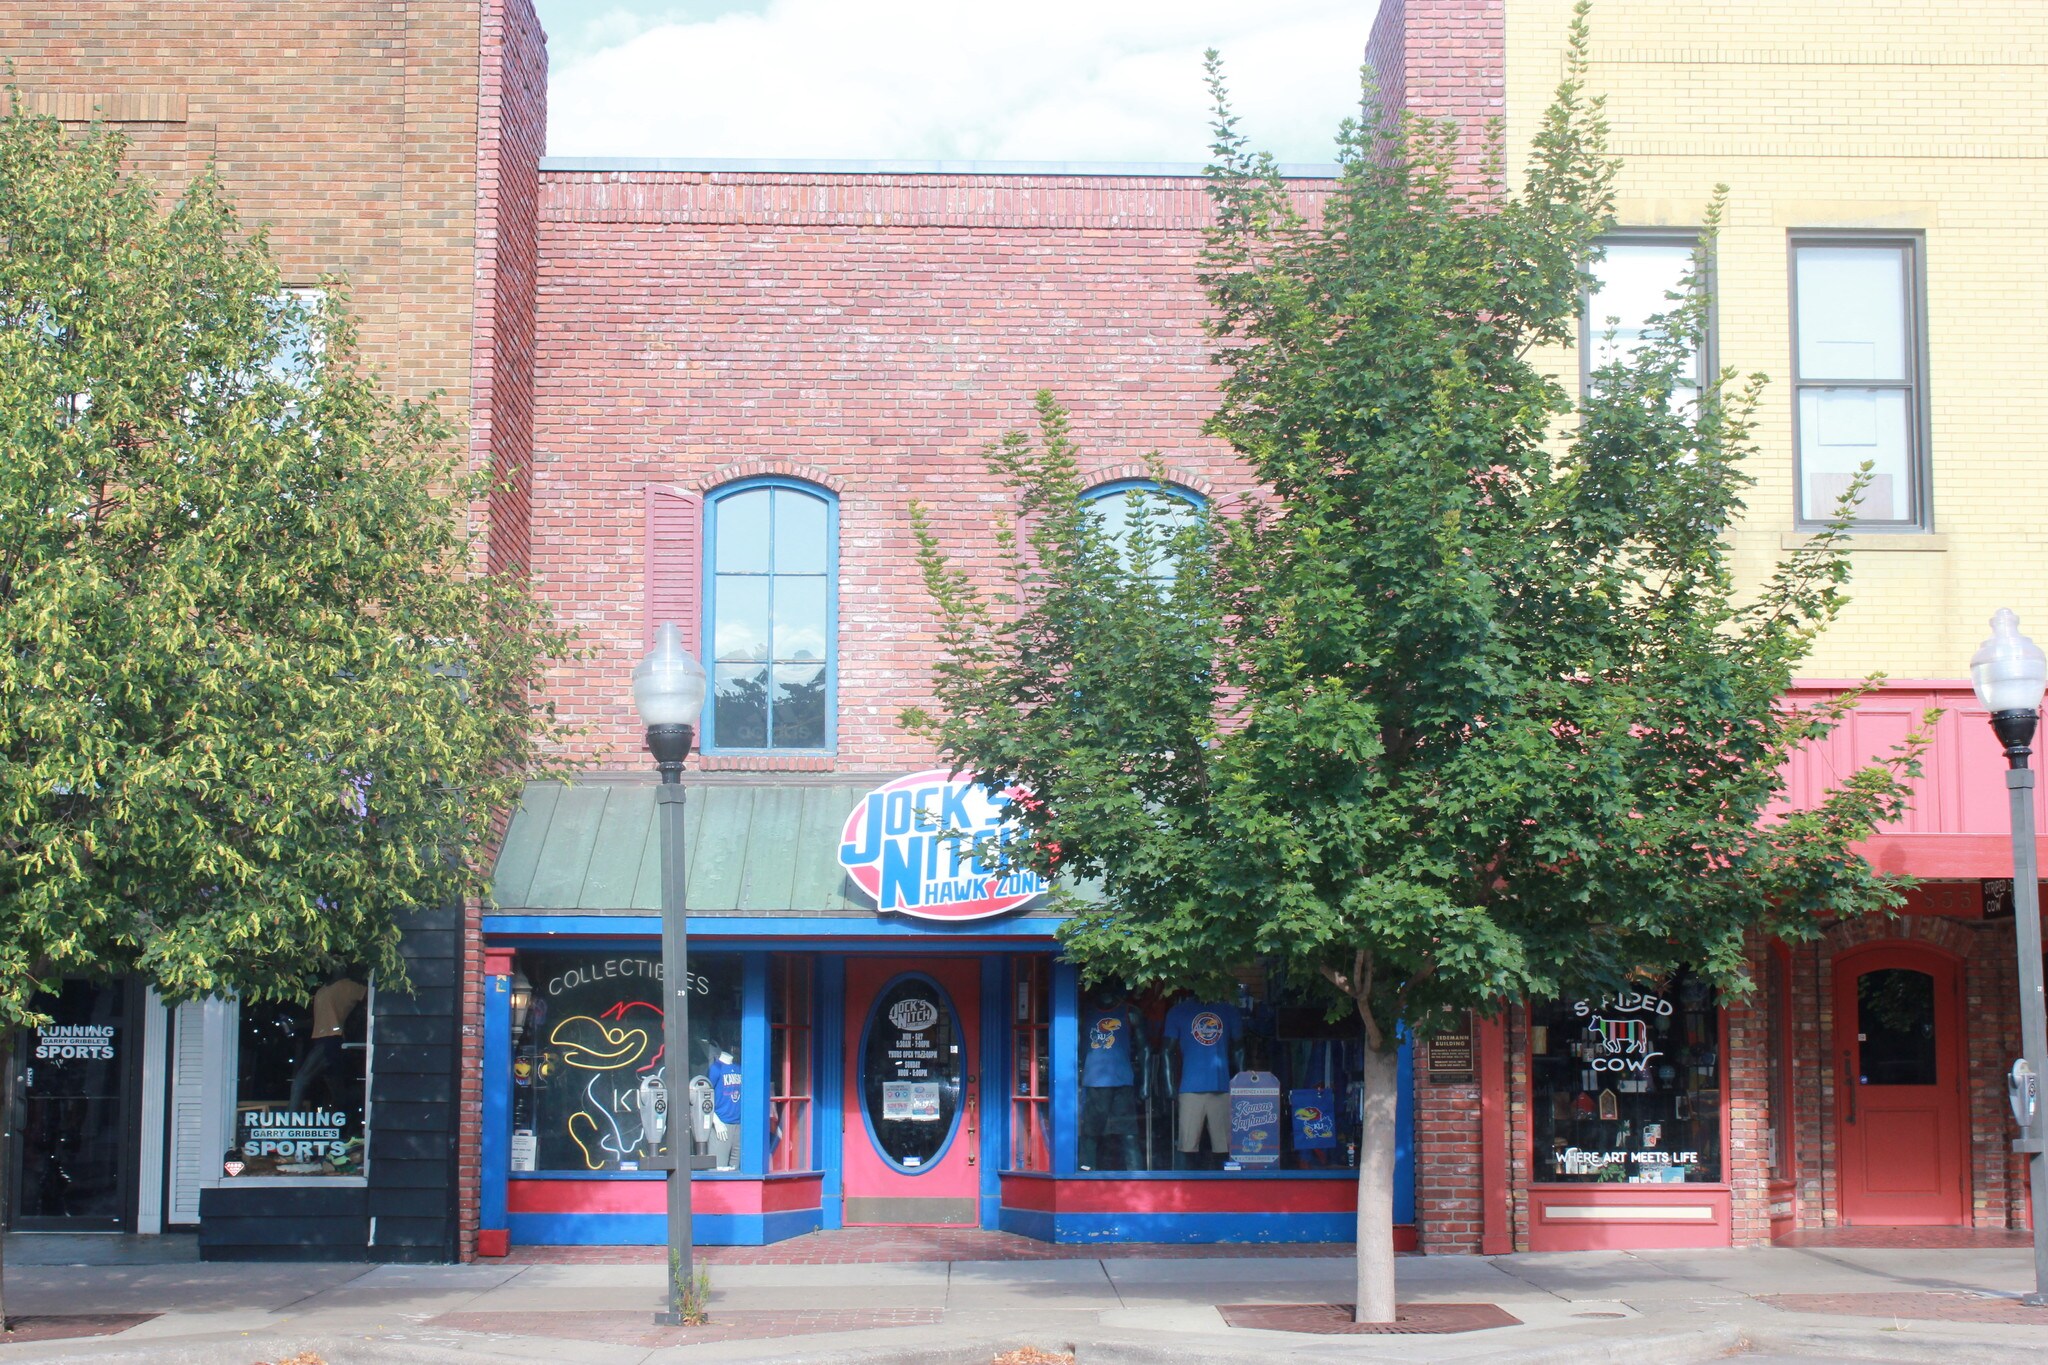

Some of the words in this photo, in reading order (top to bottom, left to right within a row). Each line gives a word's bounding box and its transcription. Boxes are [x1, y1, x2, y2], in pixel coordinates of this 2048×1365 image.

[841, 779, 1013, 865] JOCK'S
[925, 878, 988, 905] HAWK
[995, 872, 1048, 897] ZONE
[1984, 879, 2007, 898] STRIPED
[1986, 893, 2005, 912] COW
[549, 959, 709, 996] COLLECTIBES
[889, 1000, 927, 1020] JOCK'S
[1574, 992, 1674, 1016] SIPED
[898, 1010, 931, 1029] NITCH
[37, 1025, 115, 1037] RUNNING
[35, 1045, 115, 1059] SPORTS
[1591, 1052, 1663, 1072] COW
[614, 1089, 641, 1113] K
[1236, 1100, 1273, 1116] Kansas
[244, 1111, 346, 1127] RUNNING
[1232, 1111, 1278, 1132] Jayhawks
[244, 1141, 346, 1157] SPORTS
[1556, 1148, 1603, 1167] WHERE
[1603, 1151, 1627, 1163] ART
[1630, 1151, 1669, 1163] MEETS
[1673, 1151, 1698, 1163] LIFE
